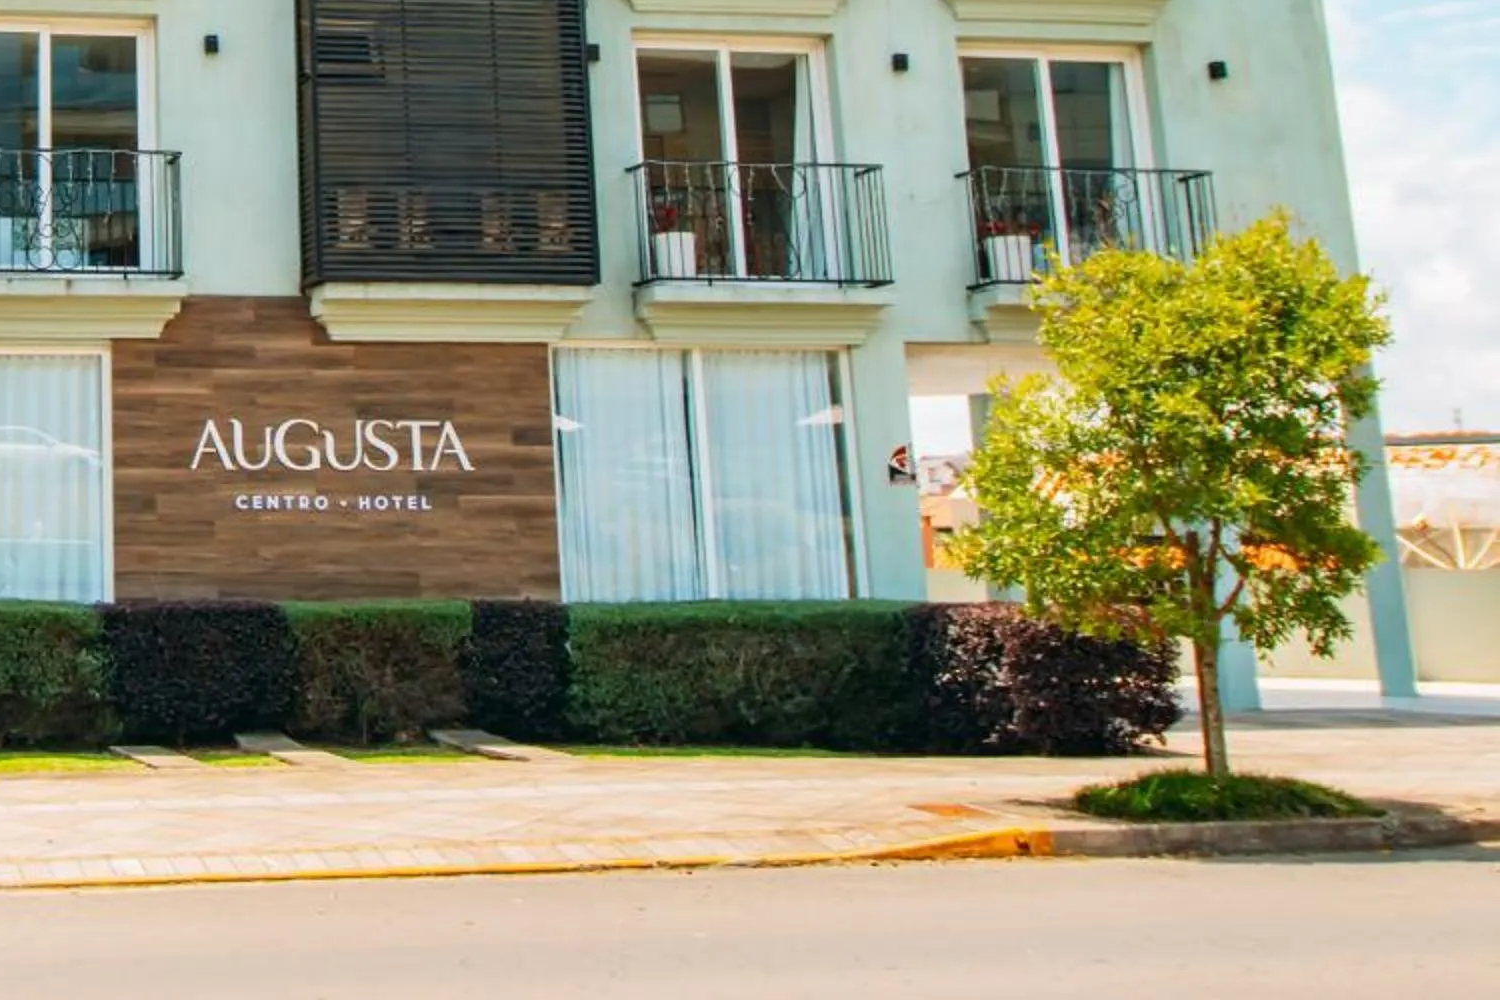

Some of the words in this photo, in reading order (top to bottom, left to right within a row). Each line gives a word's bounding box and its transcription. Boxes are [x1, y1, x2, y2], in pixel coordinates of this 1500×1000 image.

[190, 418, 475, 471] AUGUSTA
[235, 495, 329, 510] CENTRO
[358, 495, 432, 510] HOTEL
